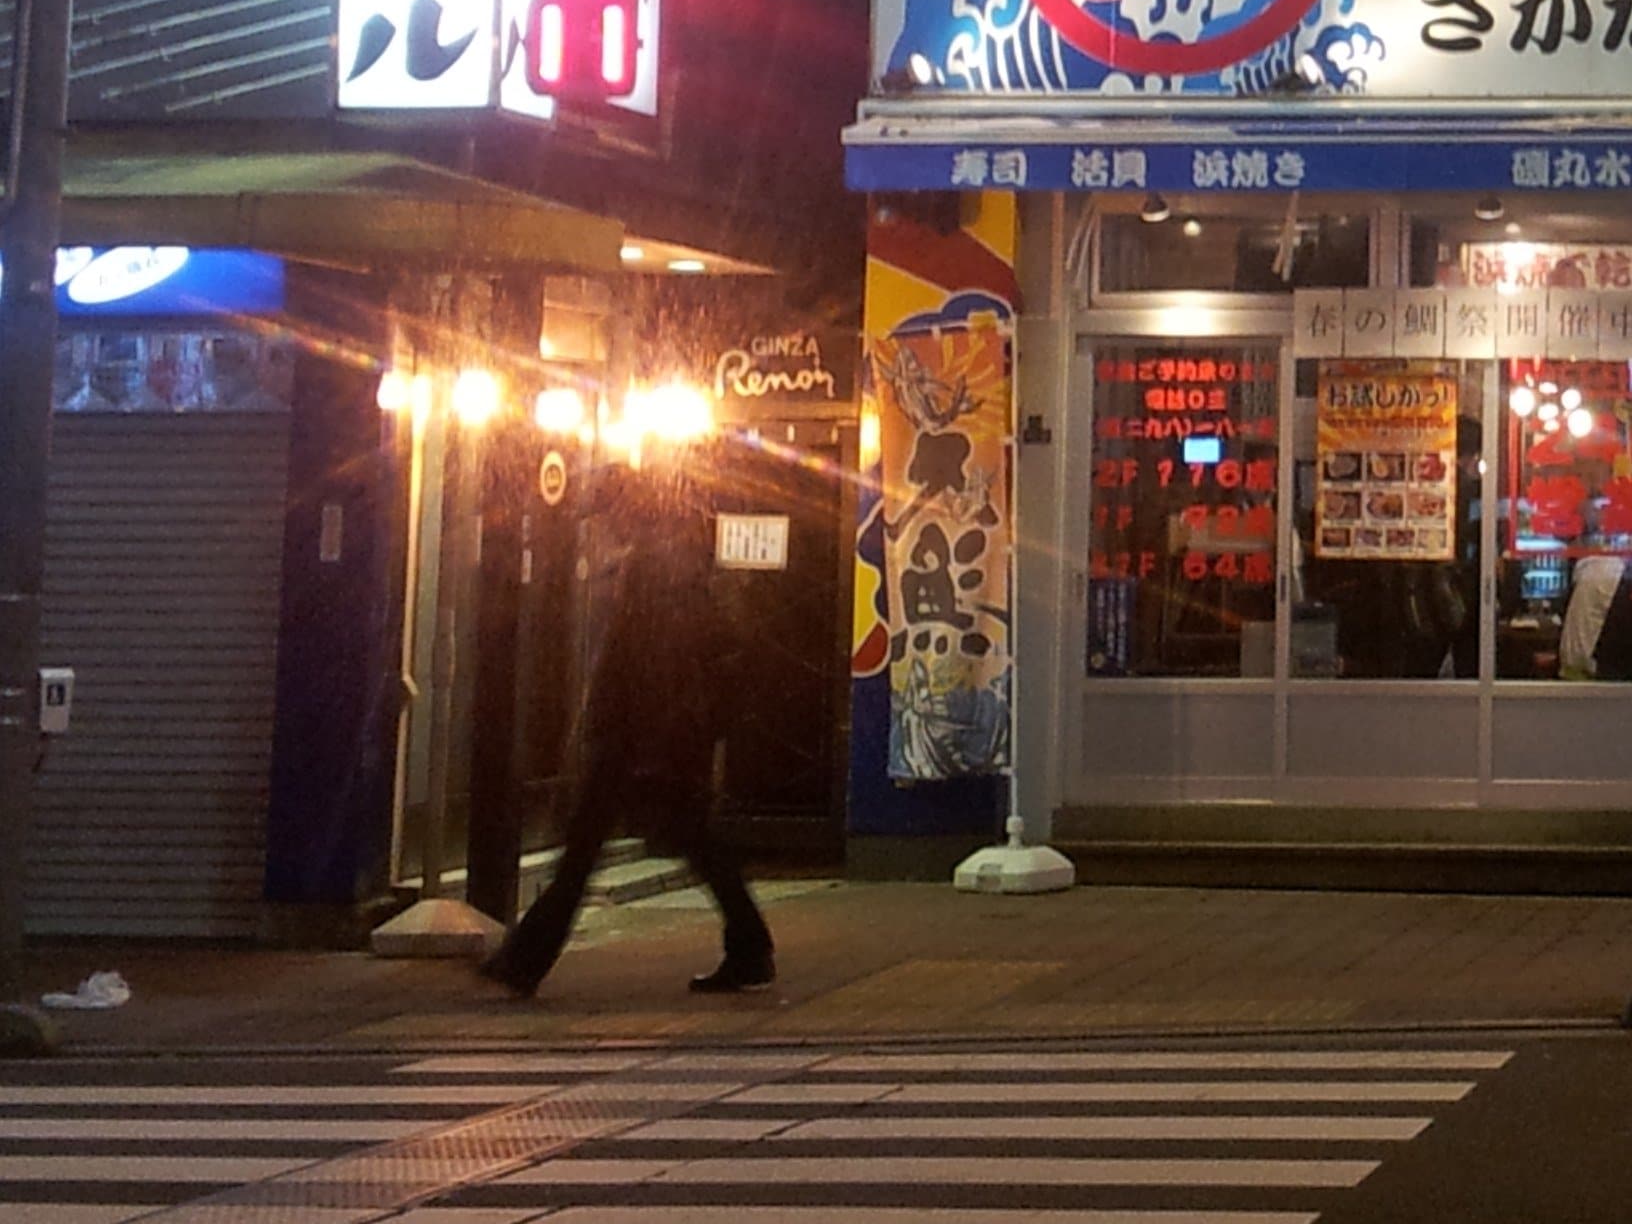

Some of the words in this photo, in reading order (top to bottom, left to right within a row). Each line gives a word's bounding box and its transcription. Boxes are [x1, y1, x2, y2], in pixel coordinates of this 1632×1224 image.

[951, 149, 1028, 187] 寿司
[1192, 149, 1306, 187] 浜焼き
[752, 335, 820, 357] GINZA
